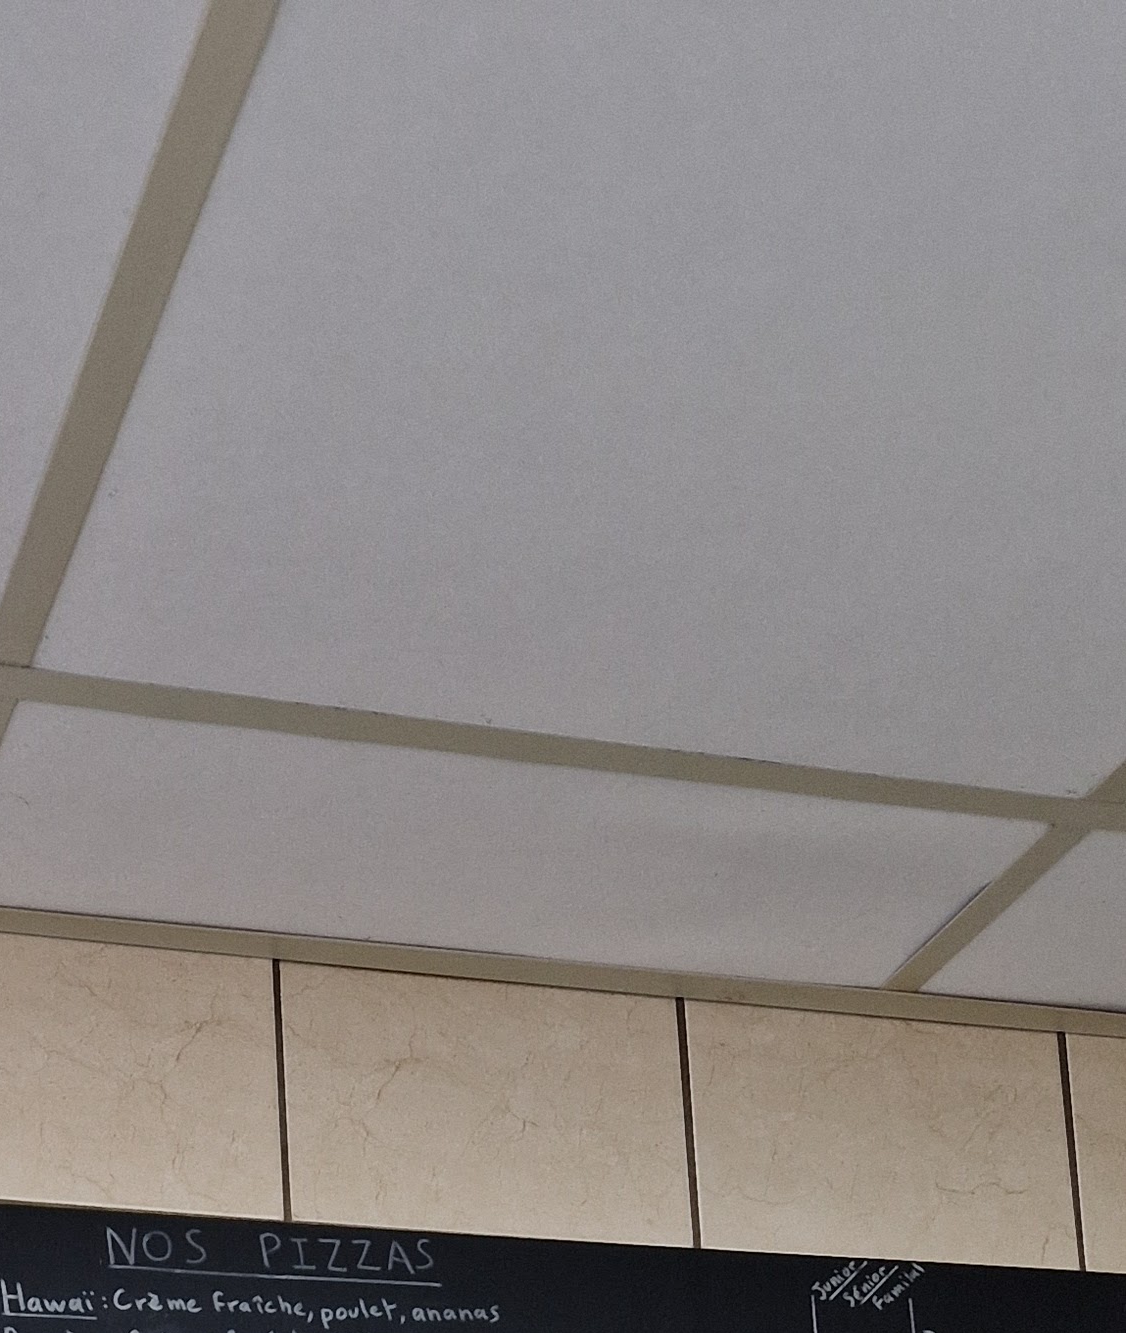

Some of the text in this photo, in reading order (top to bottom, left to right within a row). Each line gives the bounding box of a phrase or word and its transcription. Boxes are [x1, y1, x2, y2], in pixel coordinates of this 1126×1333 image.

[107, 1226, 434, 1274] NOS PIZZAS
[113, 1288, 201, 1312] Crème
[411, 1304, 499, 1323] ananas
